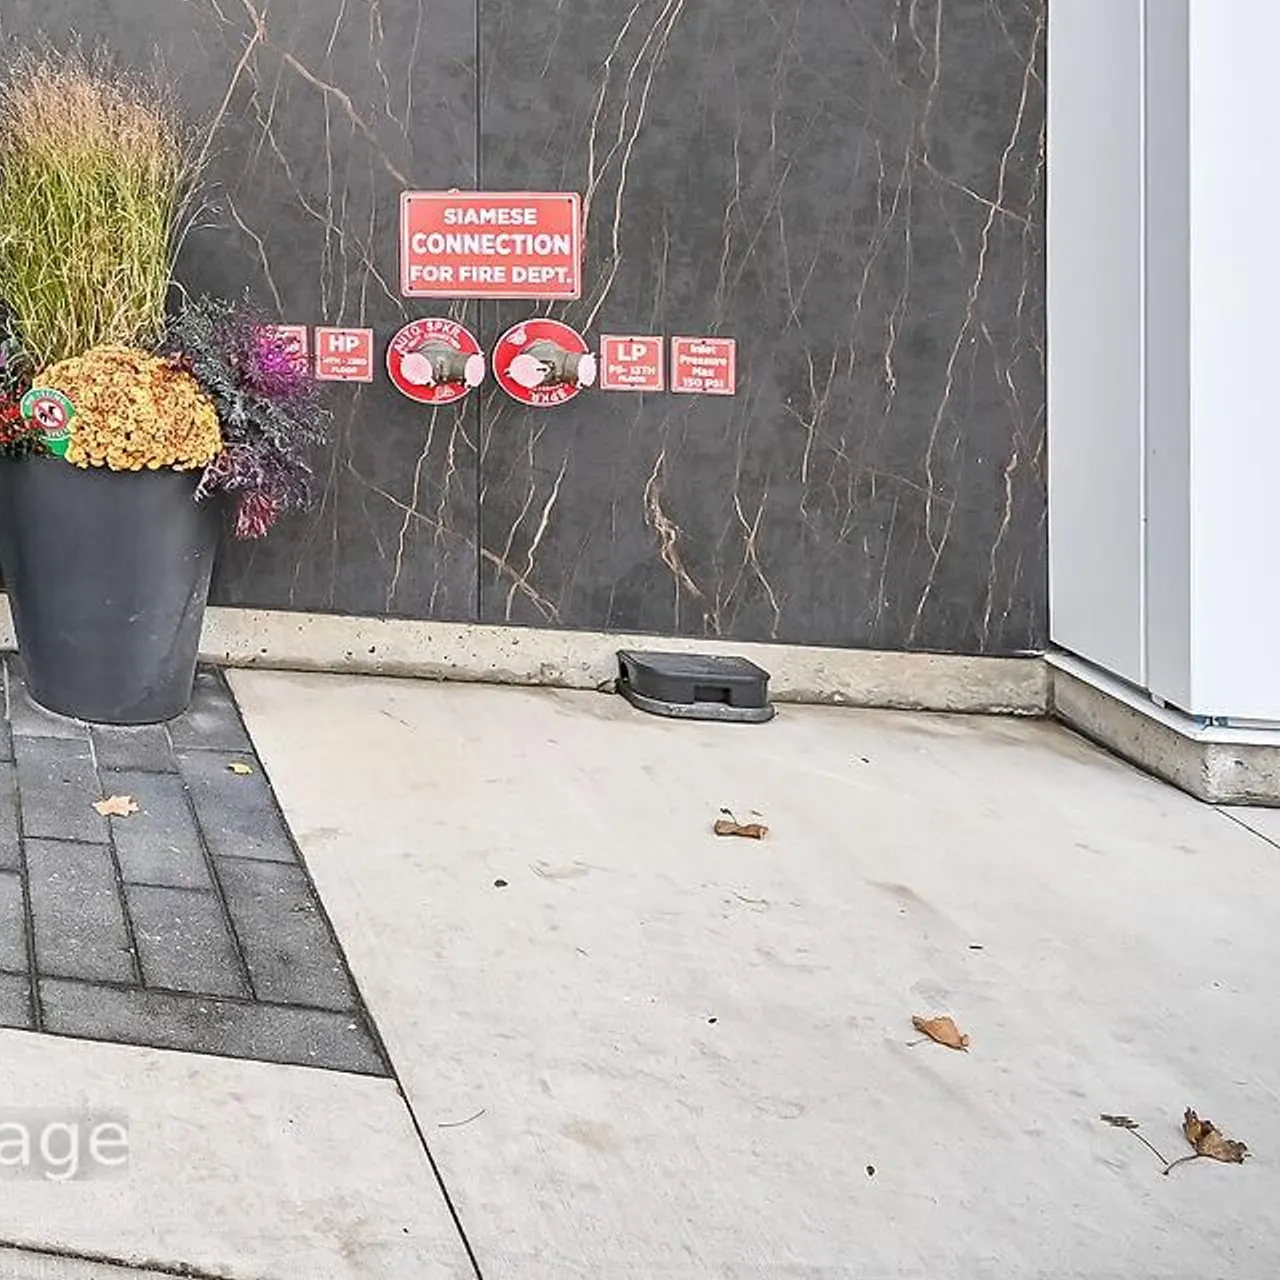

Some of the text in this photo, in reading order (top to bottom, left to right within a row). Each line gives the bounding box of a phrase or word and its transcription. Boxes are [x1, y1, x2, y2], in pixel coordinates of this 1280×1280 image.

[444, 208, 537, 225] SIAMESE
[411, 232, 570, 255] CONNECTION
[410, 265, 572, 284] FOR FIRE DEPT.
[329, 334, 360, 352] HP
[617, 343, 647, 361] LP
[680, 354, 727, 366] Pressure
[683, 377, 702, 388] 150
